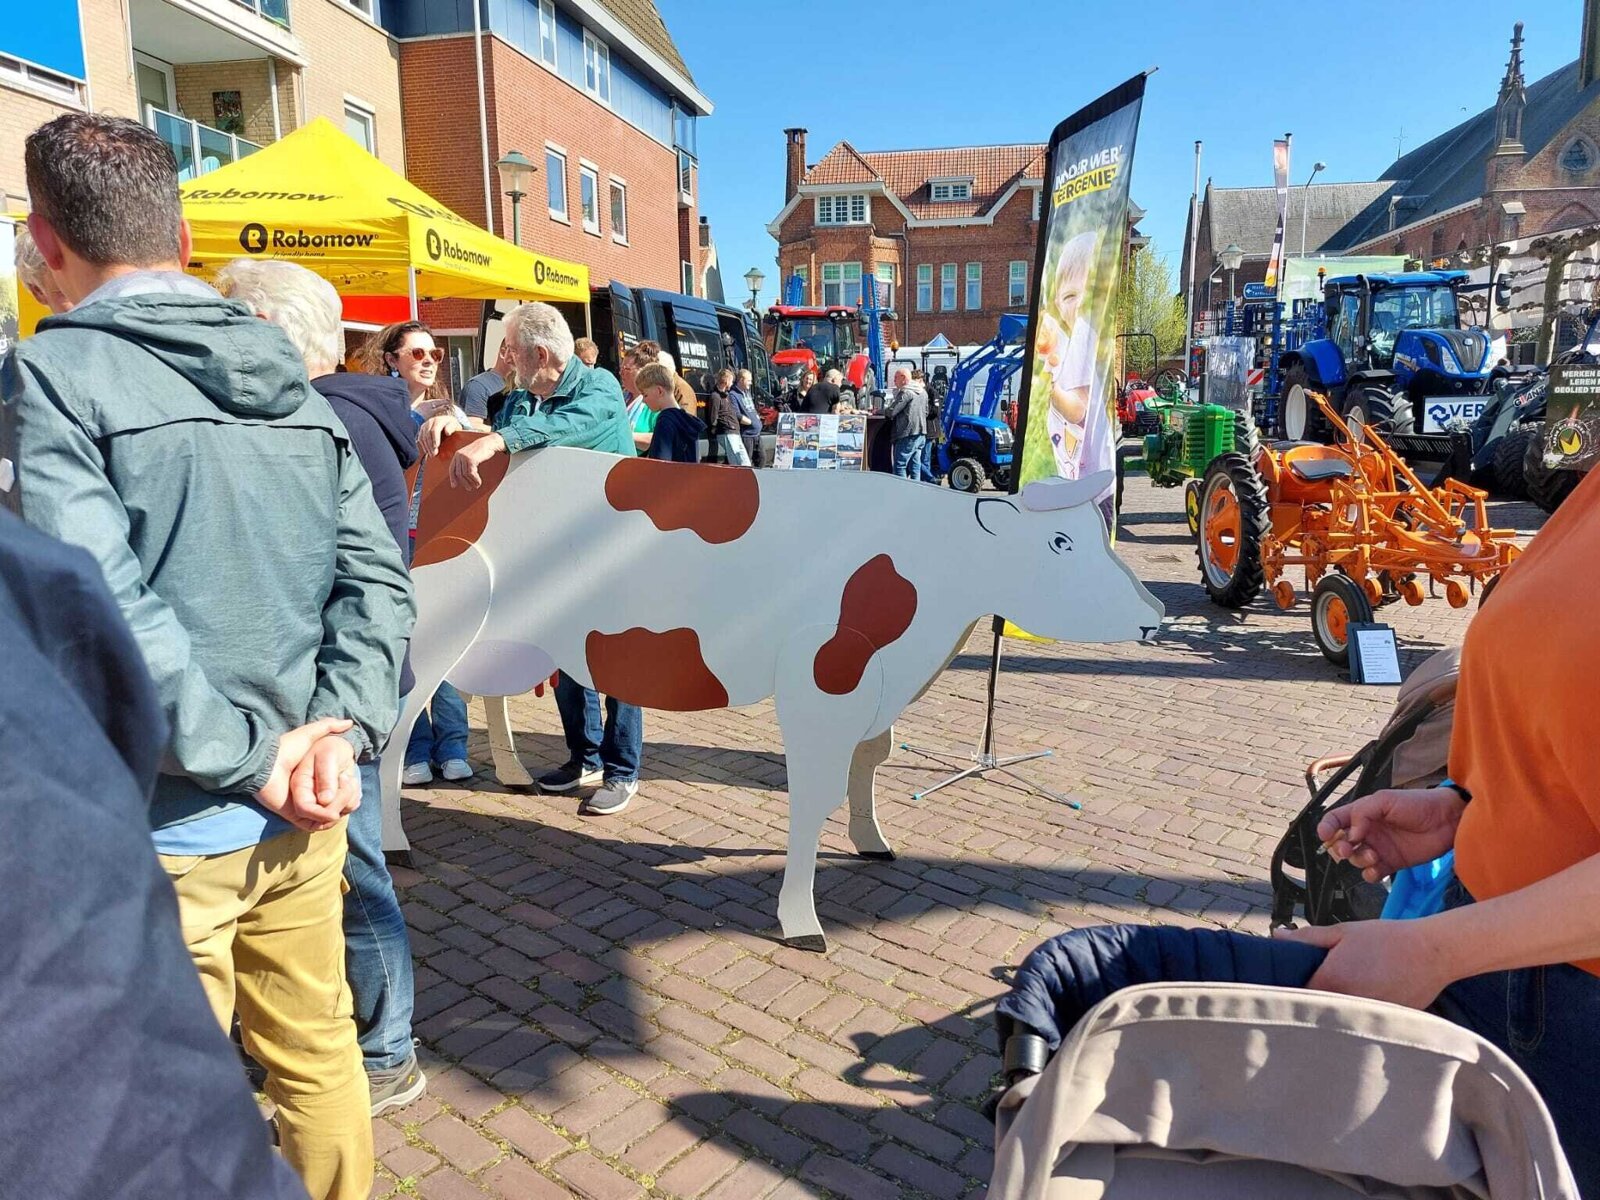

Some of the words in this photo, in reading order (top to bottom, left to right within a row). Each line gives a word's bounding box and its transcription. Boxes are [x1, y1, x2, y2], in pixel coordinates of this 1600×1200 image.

[183, 188, 334, 202] Robomow
[272, 229, 374, 248] Robomow
[443, 238, 490, 267] Robomow
[546, 266, 579, 286] Robomow
[1562, 370, 1595, 378] WERKEN
[1570, 378, 1596, 386] LEREN
[1554, 386, 1589, 394] GEOLIED
